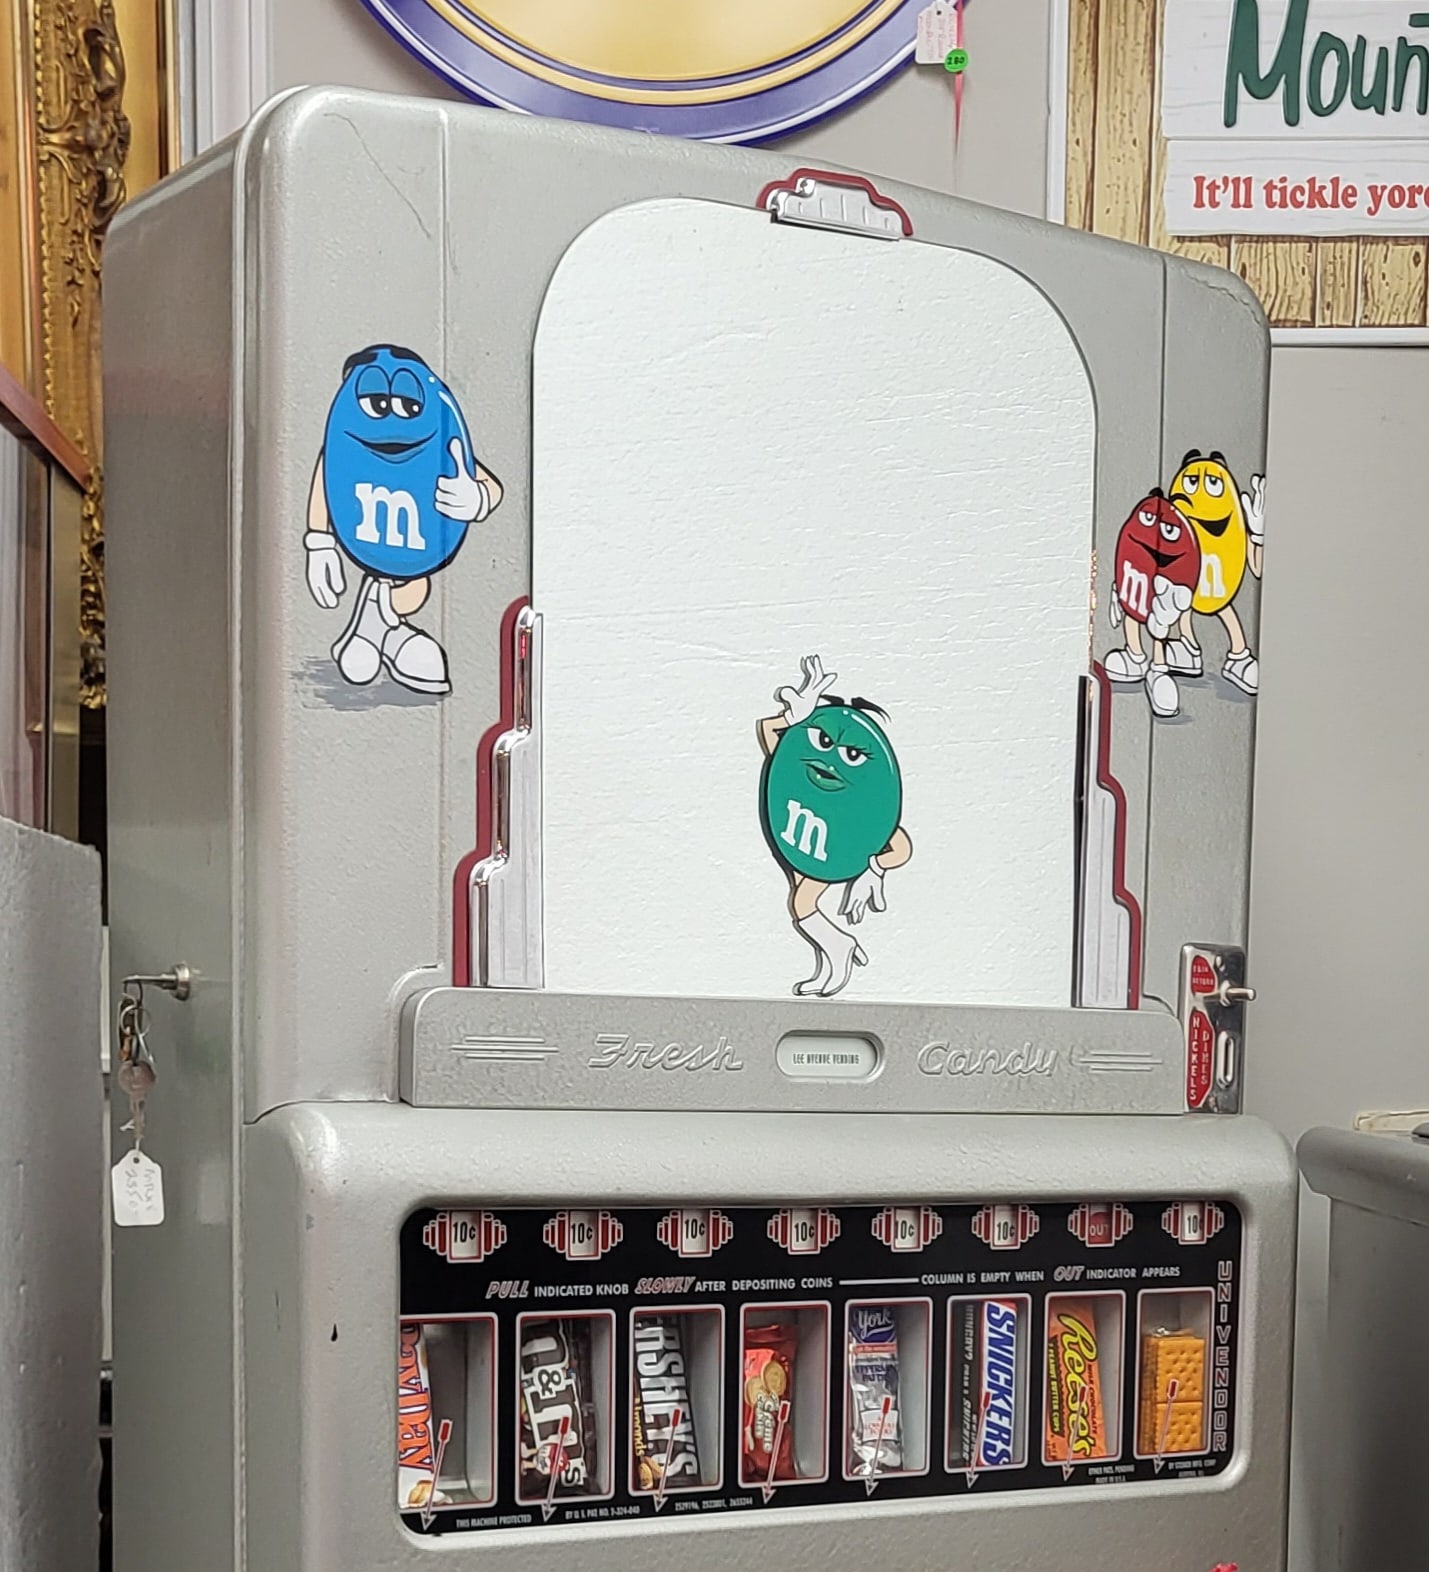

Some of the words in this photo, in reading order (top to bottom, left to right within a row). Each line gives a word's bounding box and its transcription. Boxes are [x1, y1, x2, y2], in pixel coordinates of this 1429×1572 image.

[1224, 0, 1429, 128] Moun
[1193, 176, 1253, 209] It'll
[1263, 176, 1358, 209] tickle
[588, 1033, 744, 1071] Fresh
[917, 1041, 1058, 1077] Candy
[1190, 1017, 1200, 1100] NICKELS
[1201, 1031, 1210, 1085] DIMES
[453, 1222, 476, 1243] 10¢
[571, 1223, 593, 1244] 10¢
[685, 1218, 706, 1239] 10¢
[794, 1222, 815, 1242] 10¢
[485, 1280, 530, 1299] PULL
[534, 1284, 593, 1298] INDICATED
[596, 1283, 629, 1296] KNOB
[634, 1276, 696, 1294] SLOWLY
[695, 1281, 726, 1292] AFTER
[732, 1279, 796, 1291] DEPOSITING
[801, 1277, 833, 1289] COINS
[921, 1273, 964, 1285] COLUMN
[967, 1272, 976, 1283] IS
[980, 1271, 1011, 1283] EMPTY
[1015, 1271, 1044, 1282] WHEN
[1053, 1265, 1085, 1282] OUT
[1086, 1268, 1136, 1280] INDICATOR
[1142, 1266, 1180, 1278] APPEARS
[1213, 1261, 1233, 1451] UNIVENDOR
[983, 1303, 1016, 1465] SNICKERS
[1051, 1381, 1060, 1410] BUTTER
